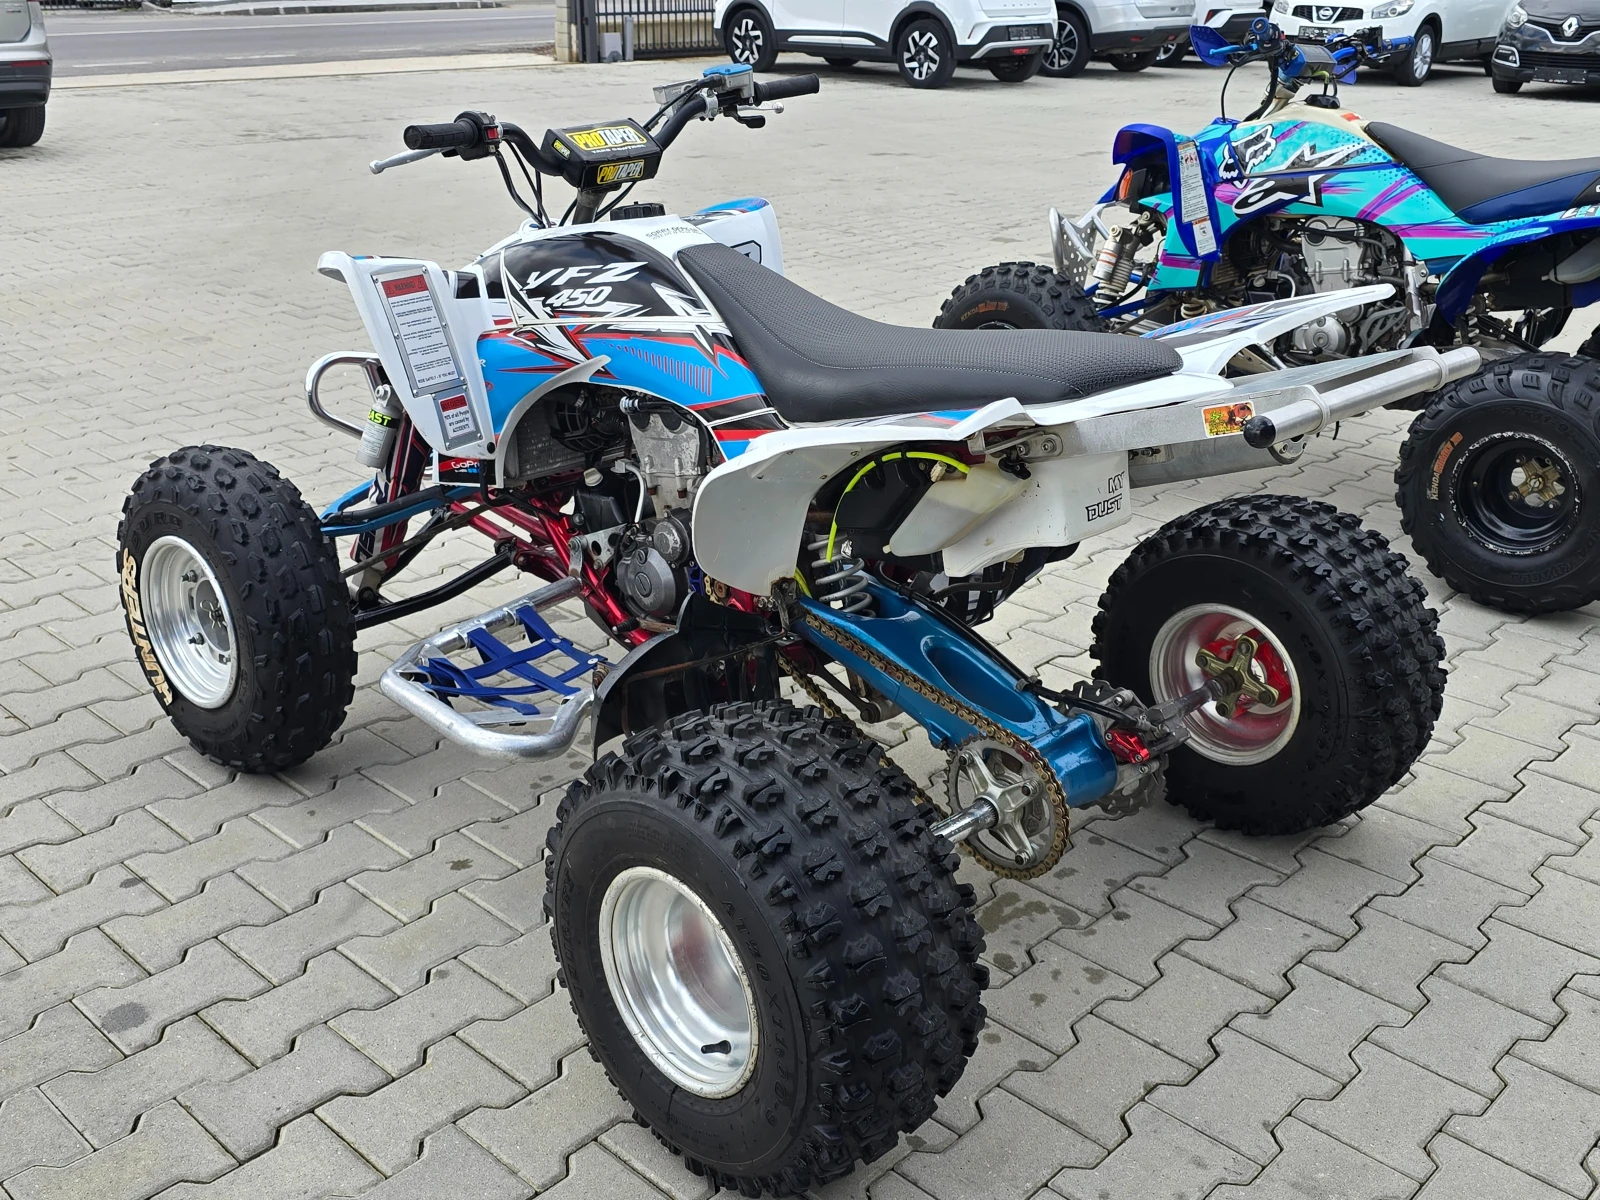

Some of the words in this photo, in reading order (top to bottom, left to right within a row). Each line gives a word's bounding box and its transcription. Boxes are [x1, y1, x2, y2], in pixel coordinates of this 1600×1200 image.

[573, 127, 640, 148] PROTAPER
[600, 161, 642, 181] PROTAPER
[523, 261, 649, 290] YFZ
[545, 286, 612, 307] 450
[1107, 471, 1125, 494] MY
[1430, 472, 1440, 500] KENDA
[1086, 493, 1122, 522] DUST
[131, 510, 183, 551] DURO
[121, 547, 173, 706] HUNTERS
